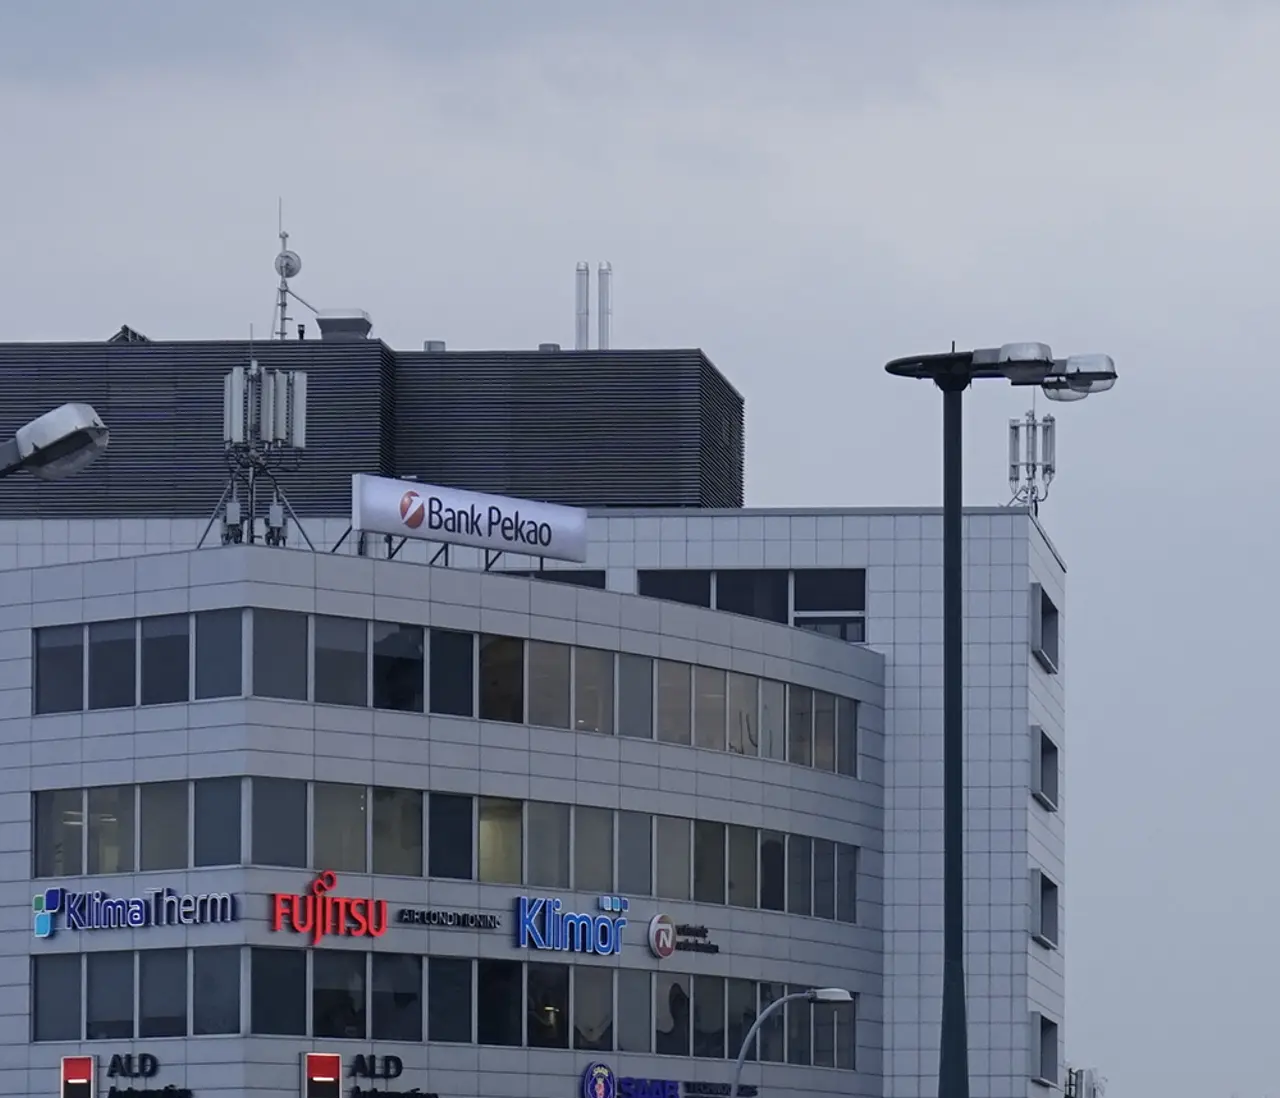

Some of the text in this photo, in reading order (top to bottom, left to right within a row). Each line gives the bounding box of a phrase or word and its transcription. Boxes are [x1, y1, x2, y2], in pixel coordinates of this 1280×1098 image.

[427, 496, 552, 547] Bank Pekao
[65, 887, 235, 930] KlimaTherm
[272, 871, 388, 946] FUJITSU
[517, 896, 628, 956] Klimor
[106, 1053, 159, 1078] ALD
[349, 1053, 404, 1079] ALD
